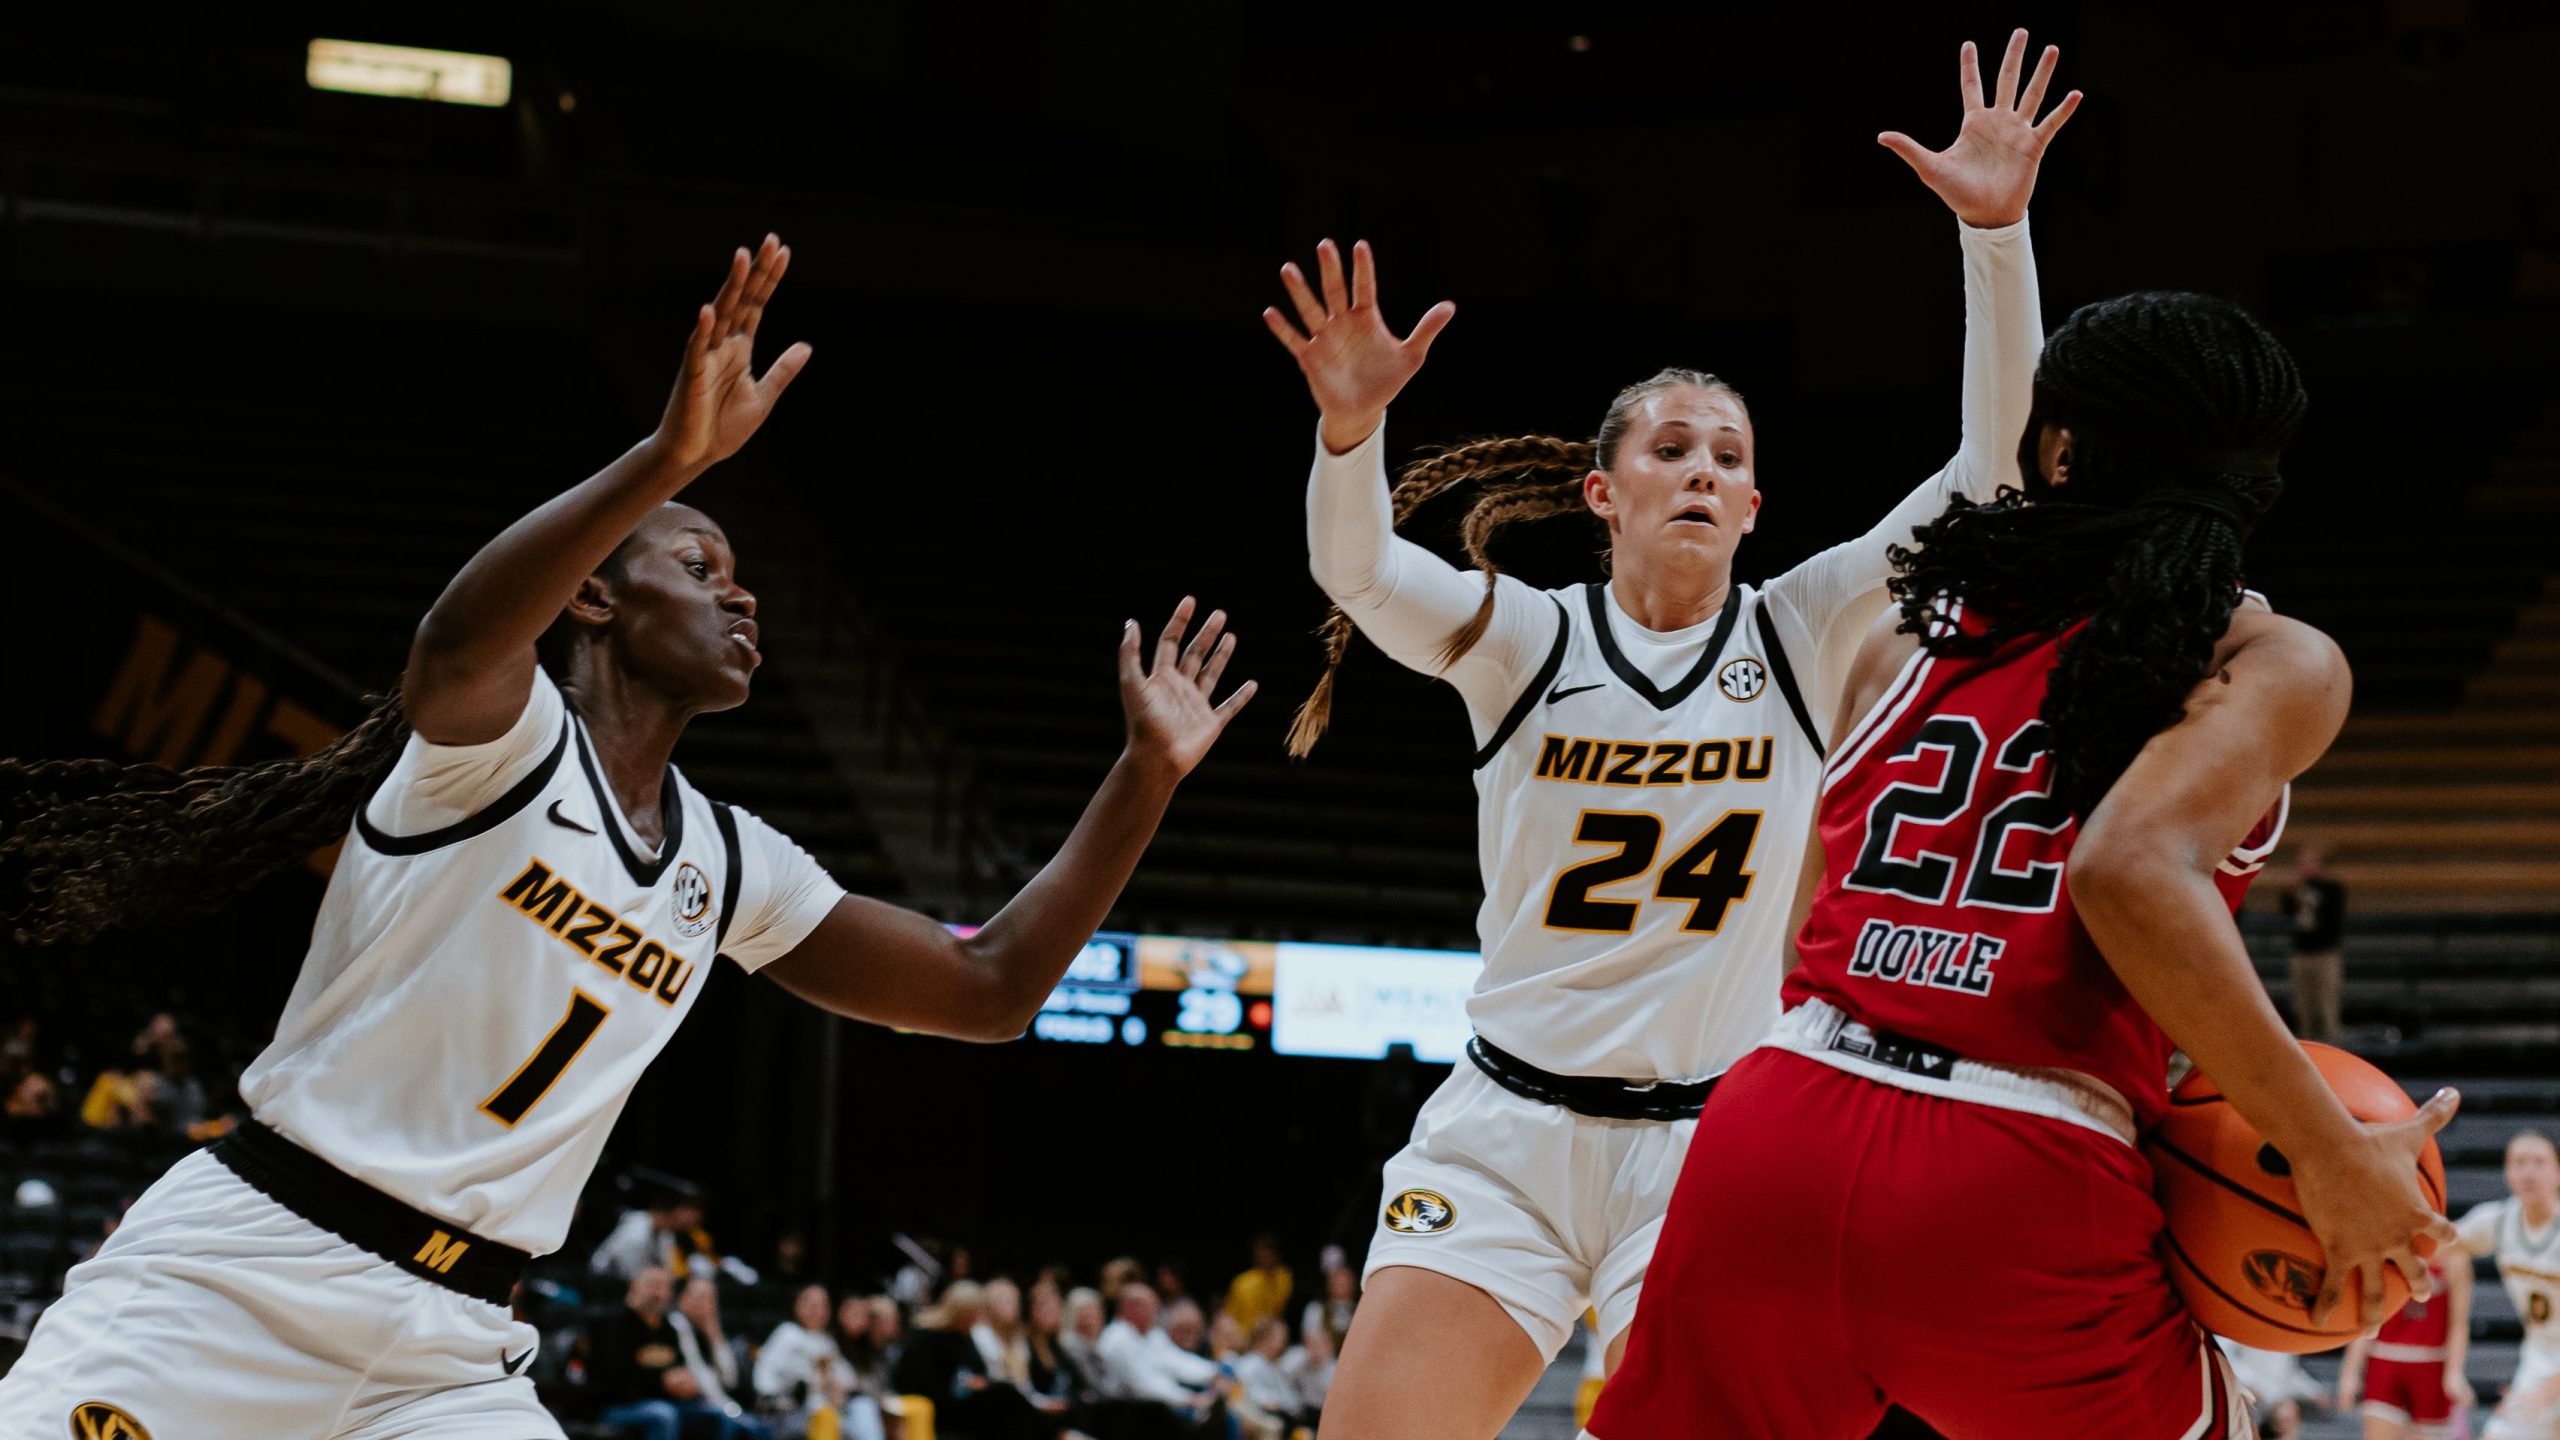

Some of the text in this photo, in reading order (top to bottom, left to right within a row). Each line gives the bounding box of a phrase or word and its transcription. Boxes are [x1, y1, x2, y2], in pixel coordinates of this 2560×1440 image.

[1719, 660, 1766, 701] SEC
[1534, 733, 1774, 788] MIZZOU
[1841, 713, 2075, 914] 22
[1542, 808, 1764, 936] 24
[497, 856, 695, 1008] MIZZOU
[1846, 917, 2008, 998] DOYLE
[477, 986, 612, 1130] 1
[411, 1228, 472, 1275] M
